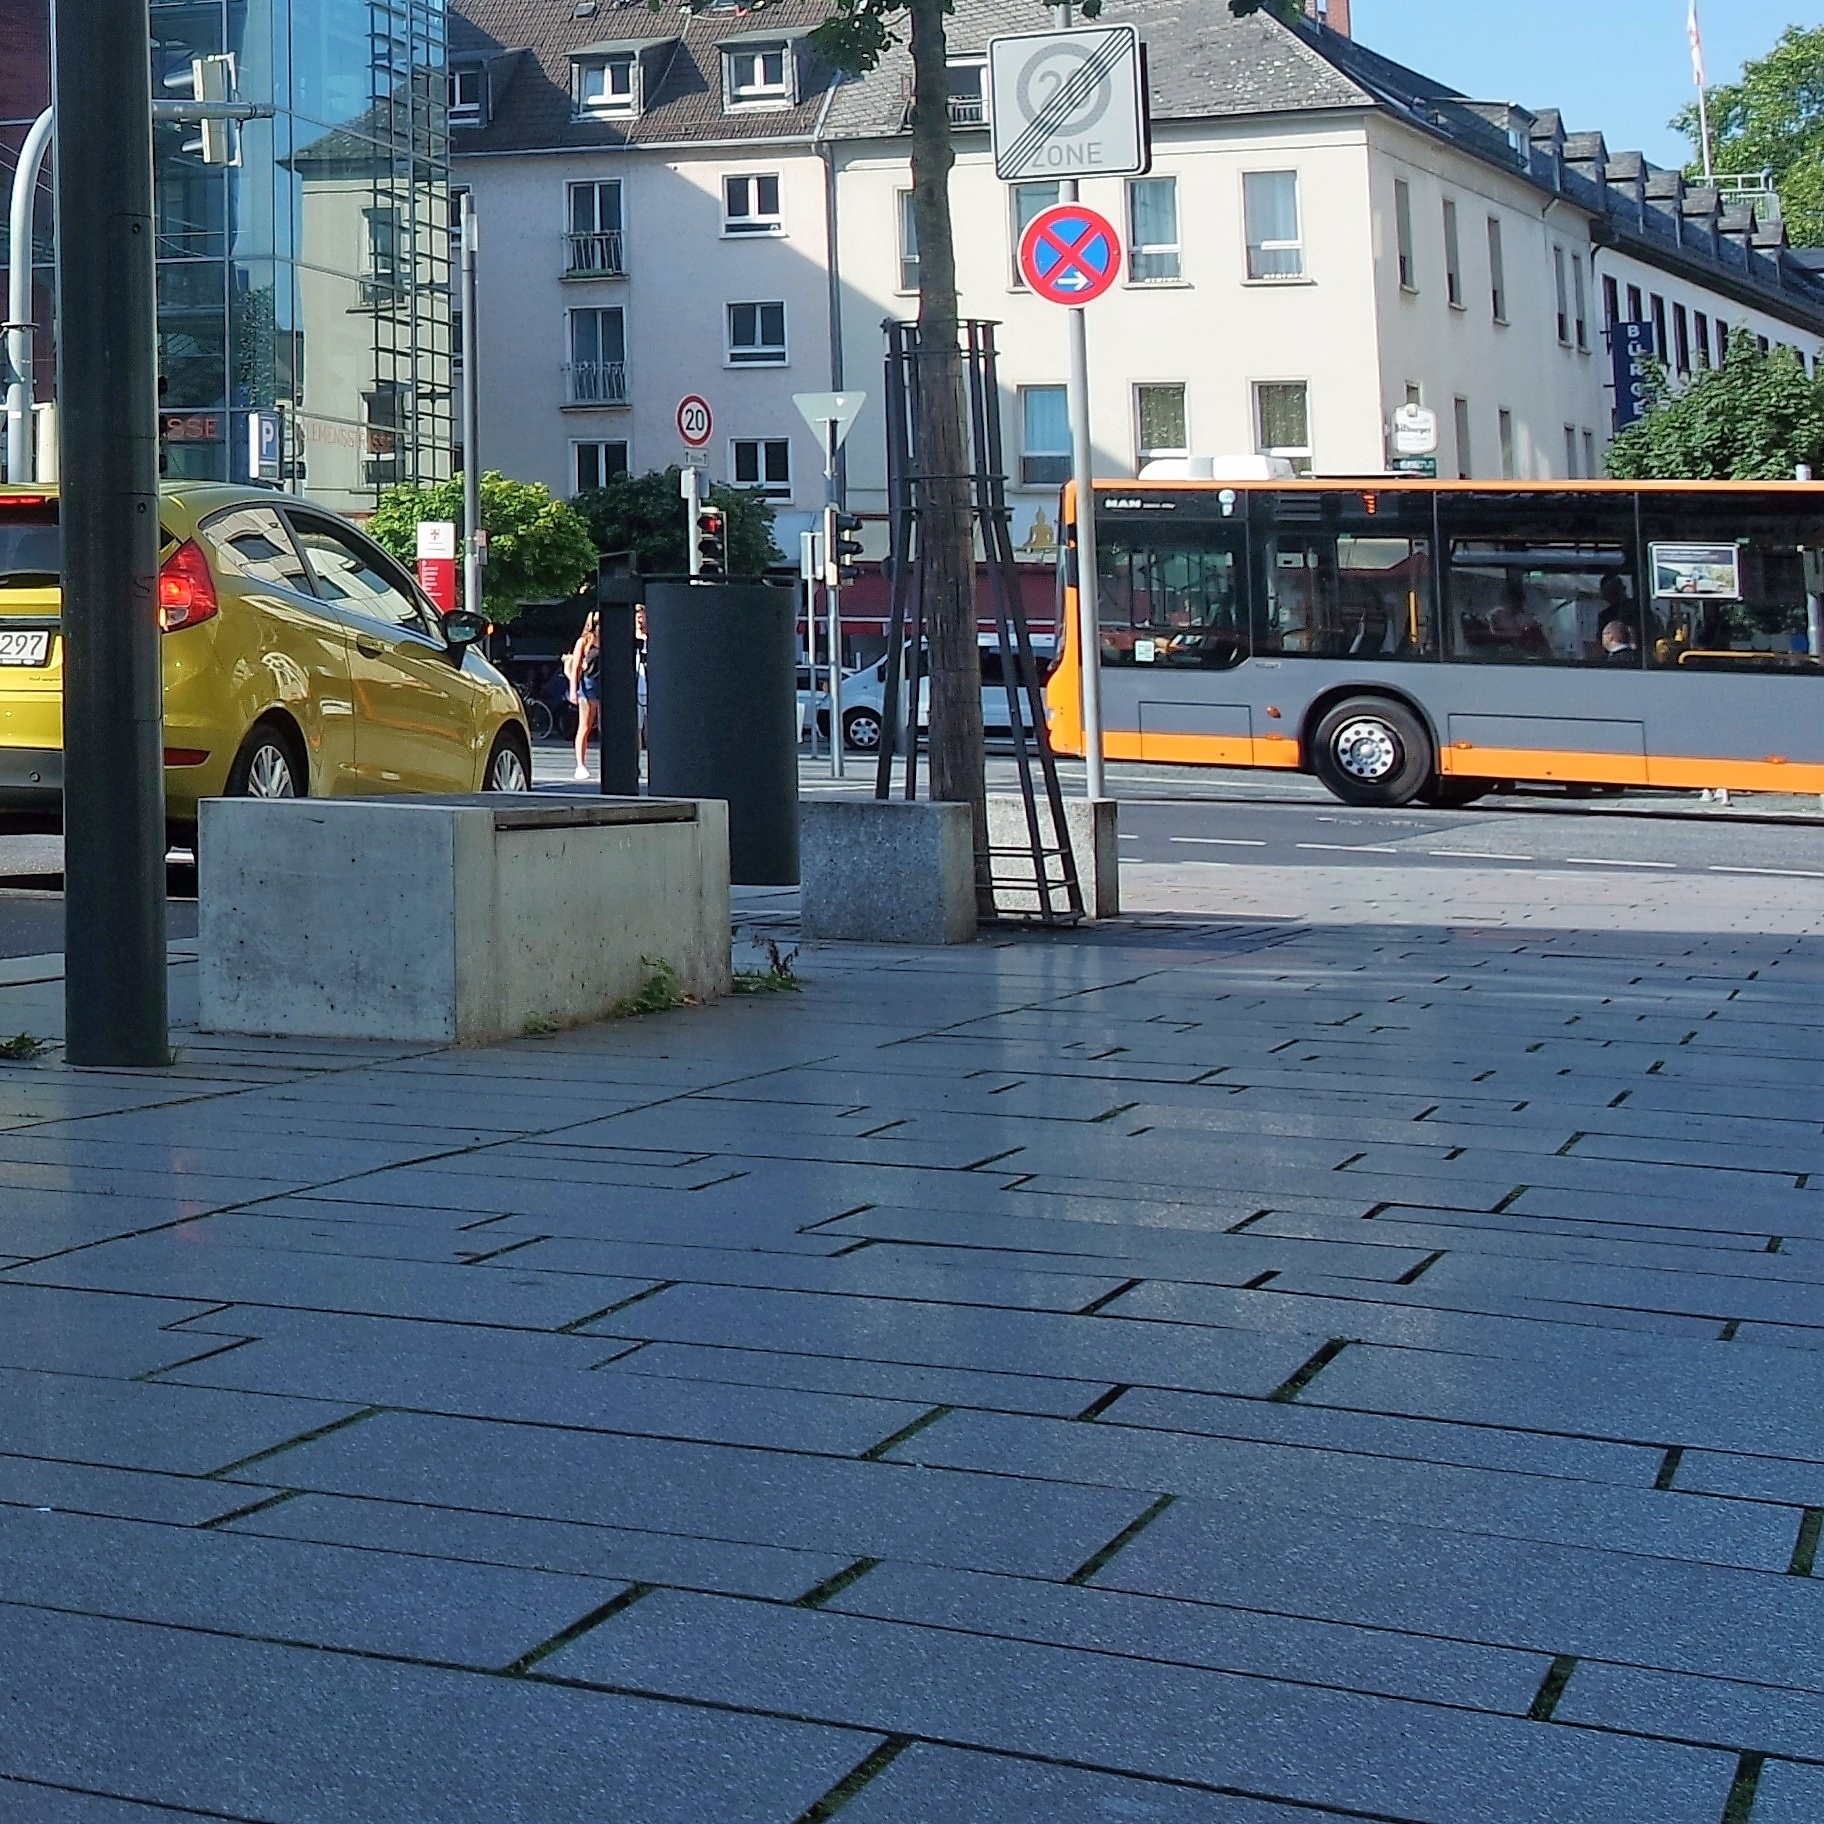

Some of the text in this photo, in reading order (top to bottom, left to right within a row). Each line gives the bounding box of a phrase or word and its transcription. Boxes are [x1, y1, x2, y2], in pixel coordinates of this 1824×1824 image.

[1031, 142, 1103, 168] ZONE
[685, 408, 705, 431] 20
[262, 420, 274, 455] P
[1104, 498, 1142, 509] MAN
